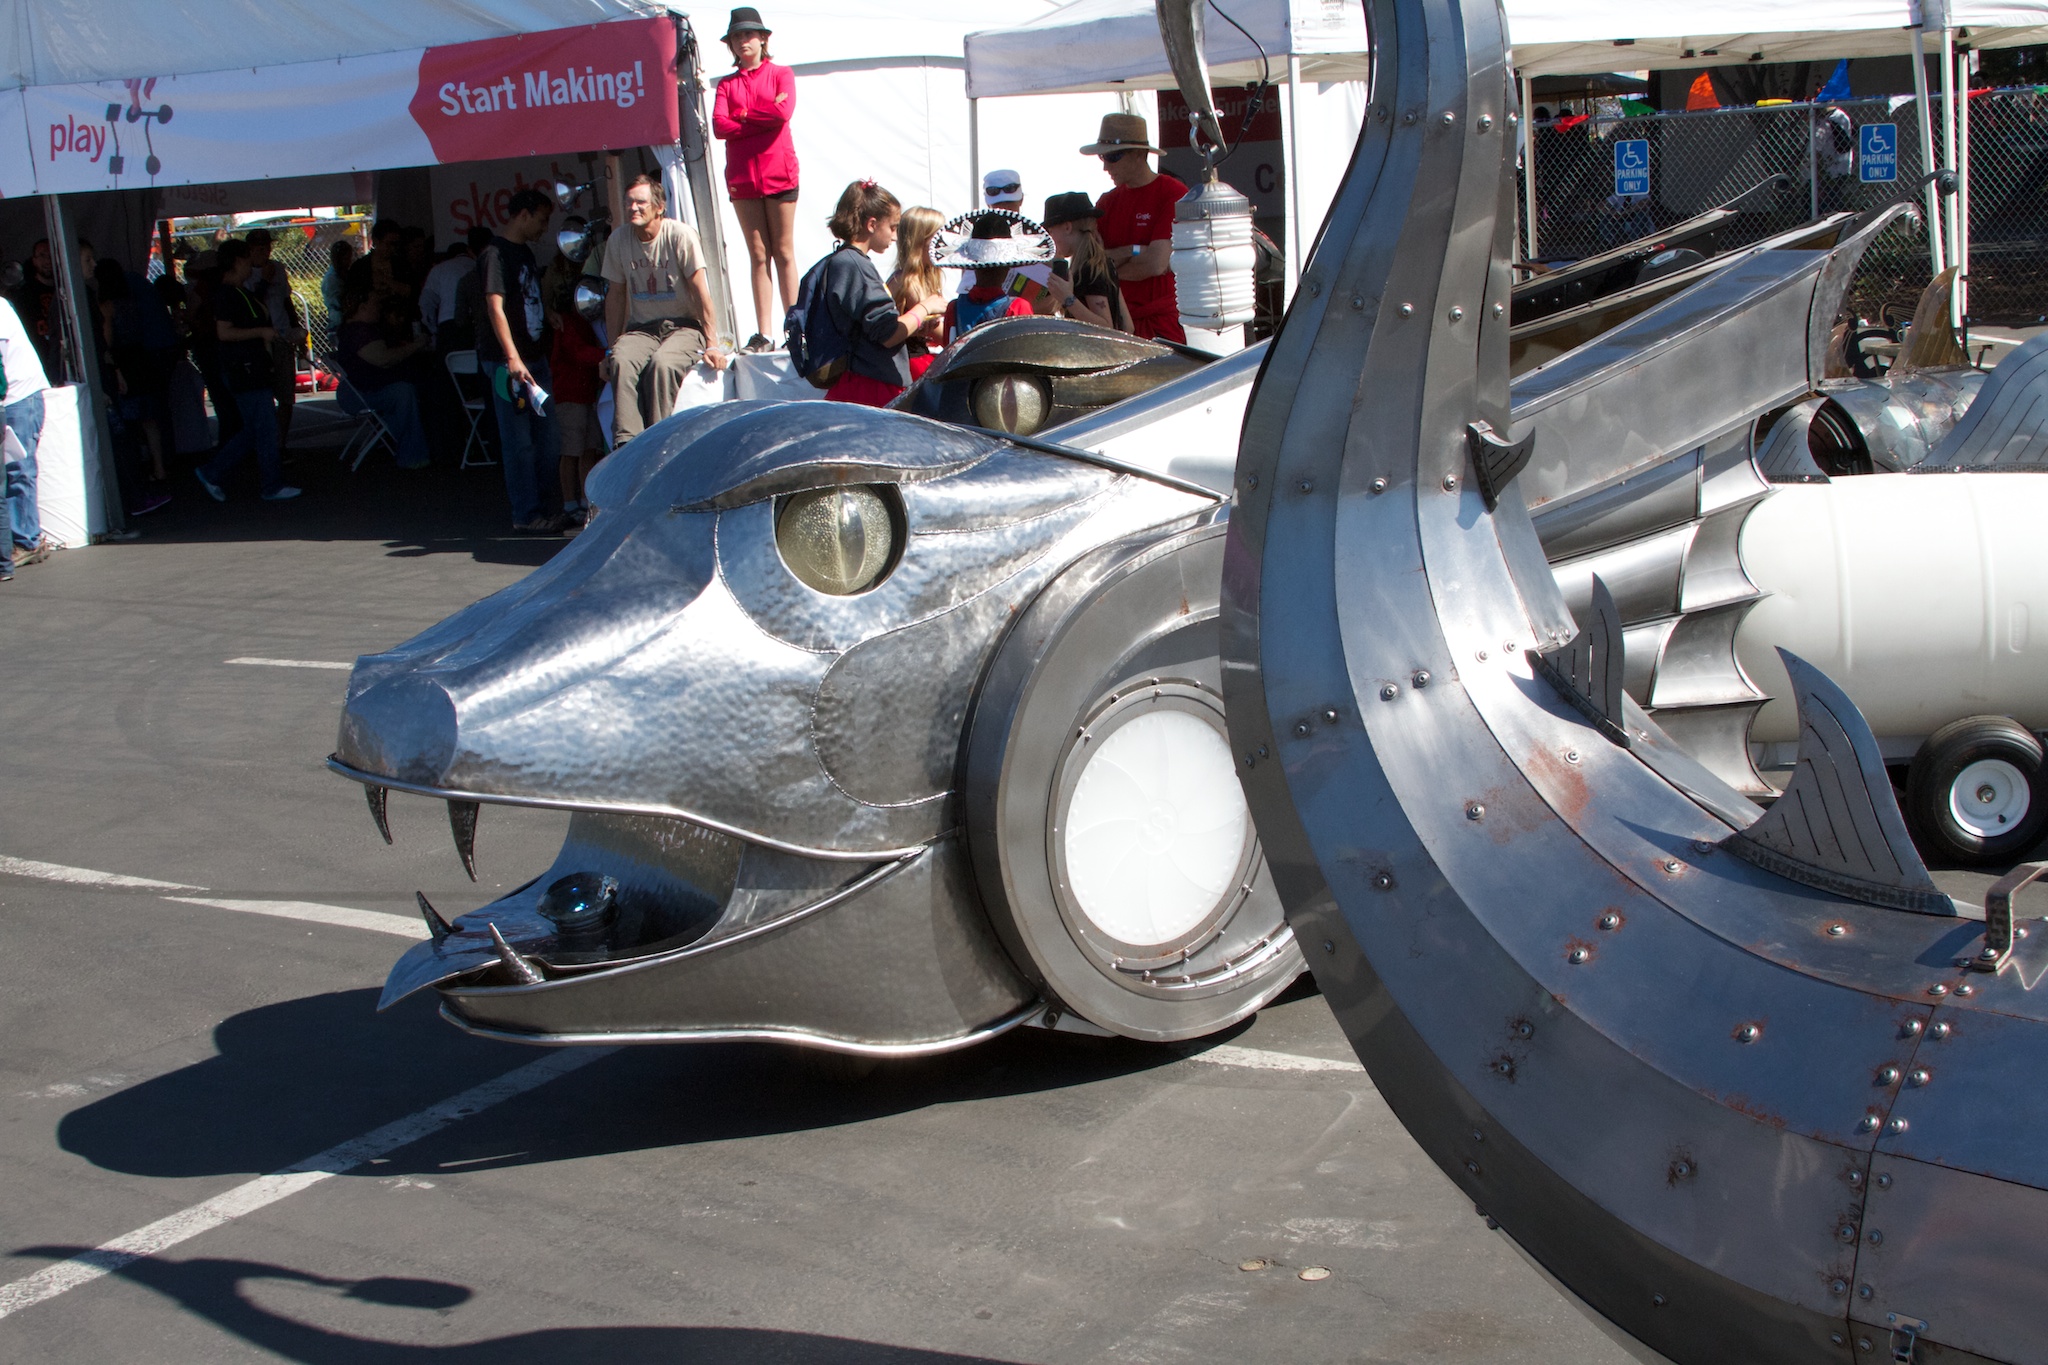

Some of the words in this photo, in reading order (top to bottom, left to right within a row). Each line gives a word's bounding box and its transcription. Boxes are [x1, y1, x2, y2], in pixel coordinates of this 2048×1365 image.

[438, 76, 518, 116] Start
[523, 60, 645, 108] Making!
[50, 114, 106, 163] play
[1862, 153, 1894, 165] PARKING
[1617, 167, 1648, 179] PARKING
[1868, 166, 1888, 178] ONLY
[1623, 180, 1641, 191] ONLY
